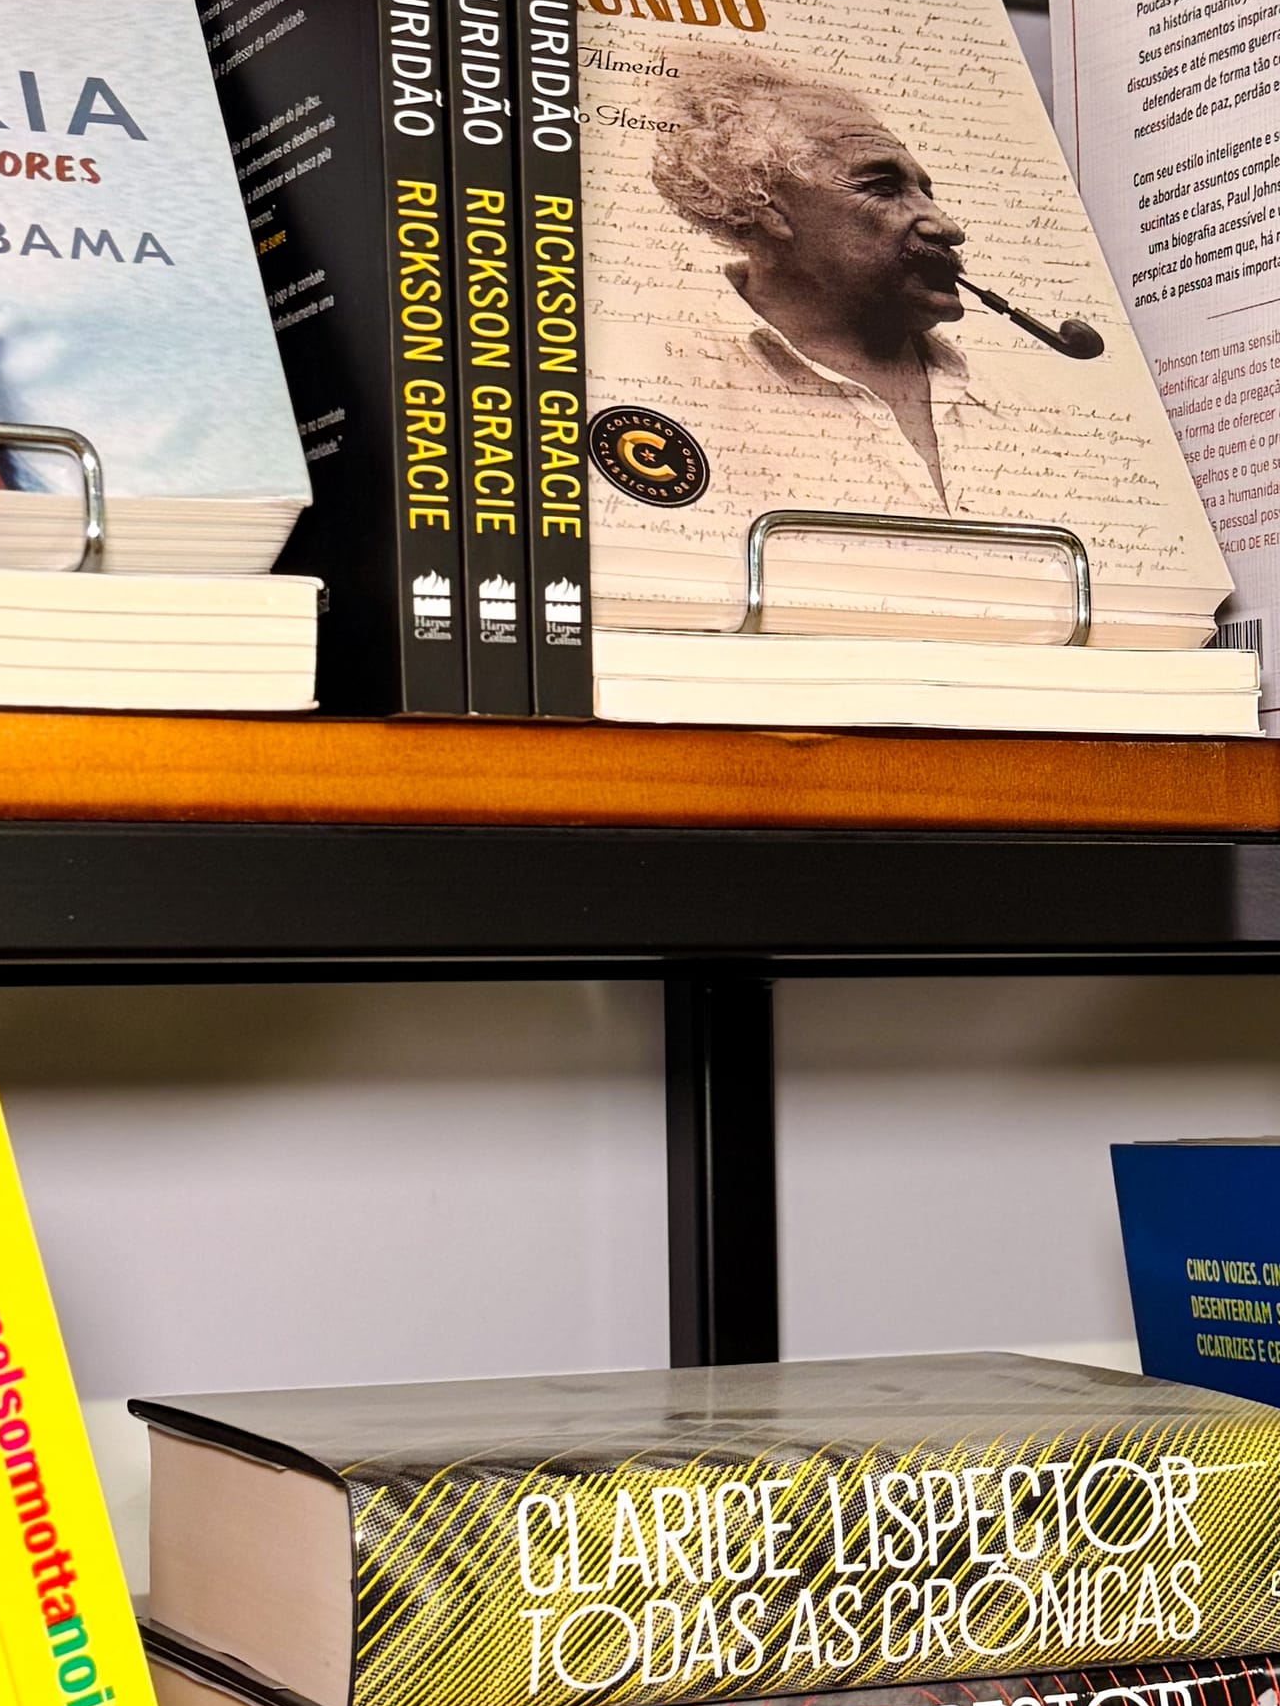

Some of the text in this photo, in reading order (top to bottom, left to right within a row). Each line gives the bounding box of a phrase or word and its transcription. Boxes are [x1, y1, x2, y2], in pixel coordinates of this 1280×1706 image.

[579, 47, 680, 78] Almeida
[596, 105, 680, 134] Gleiser
[396, 179, 449, 530] RICKSON GRACIE
[1186, 1258, 1220, 1282] CINCO
[1221, 1261, 1261, 1285] VOZES.
[1190, 1295, 1273, 1324] DESENTERRAM
[1196, 1333, 1266, 1362] CICATRIZES E
[517, 1455, 1204, 1596] CLARICE LISPECTOR
[520, 1560, 1204, 1695] TODAS AS CRÔNICAS
